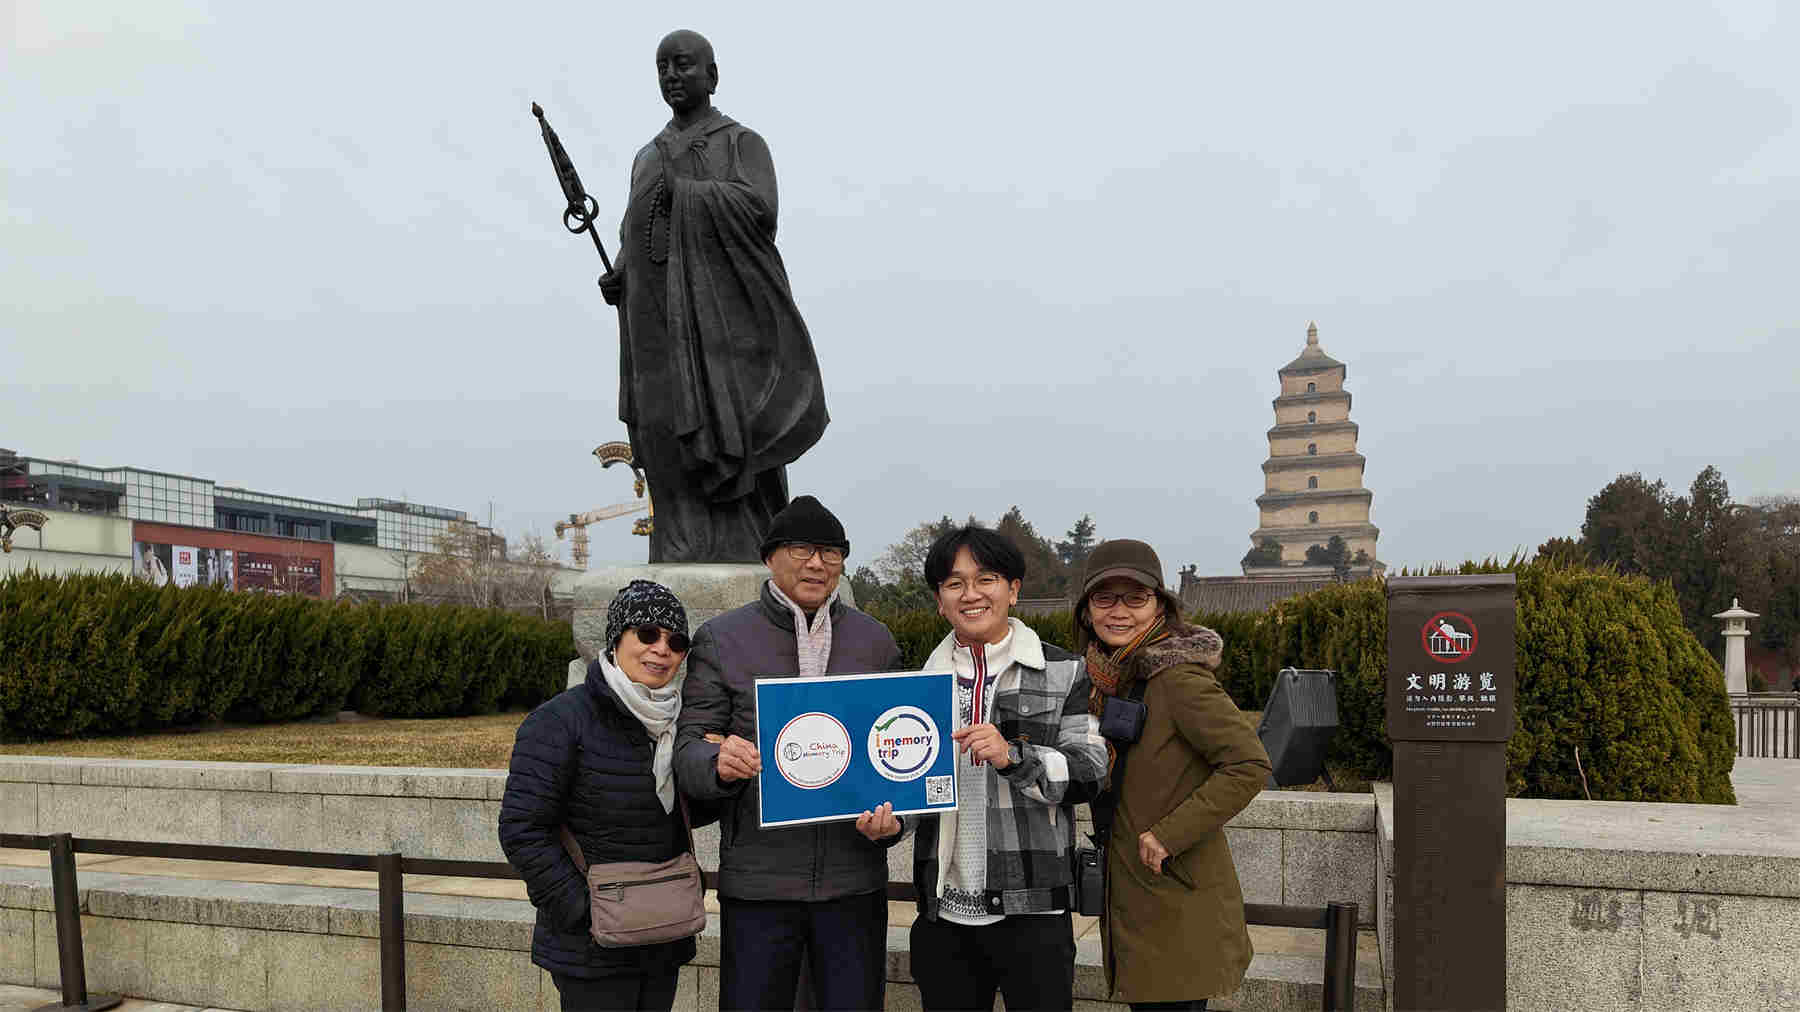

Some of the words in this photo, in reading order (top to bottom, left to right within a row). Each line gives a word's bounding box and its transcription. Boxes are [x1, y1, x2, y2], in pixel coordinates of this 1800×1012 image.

[1407, 673, 1496, 690] 文明游览
[809, 742, 838, 750] China
[884, 736, 933, 747] memory
[878, 746, 899, 760] trip
